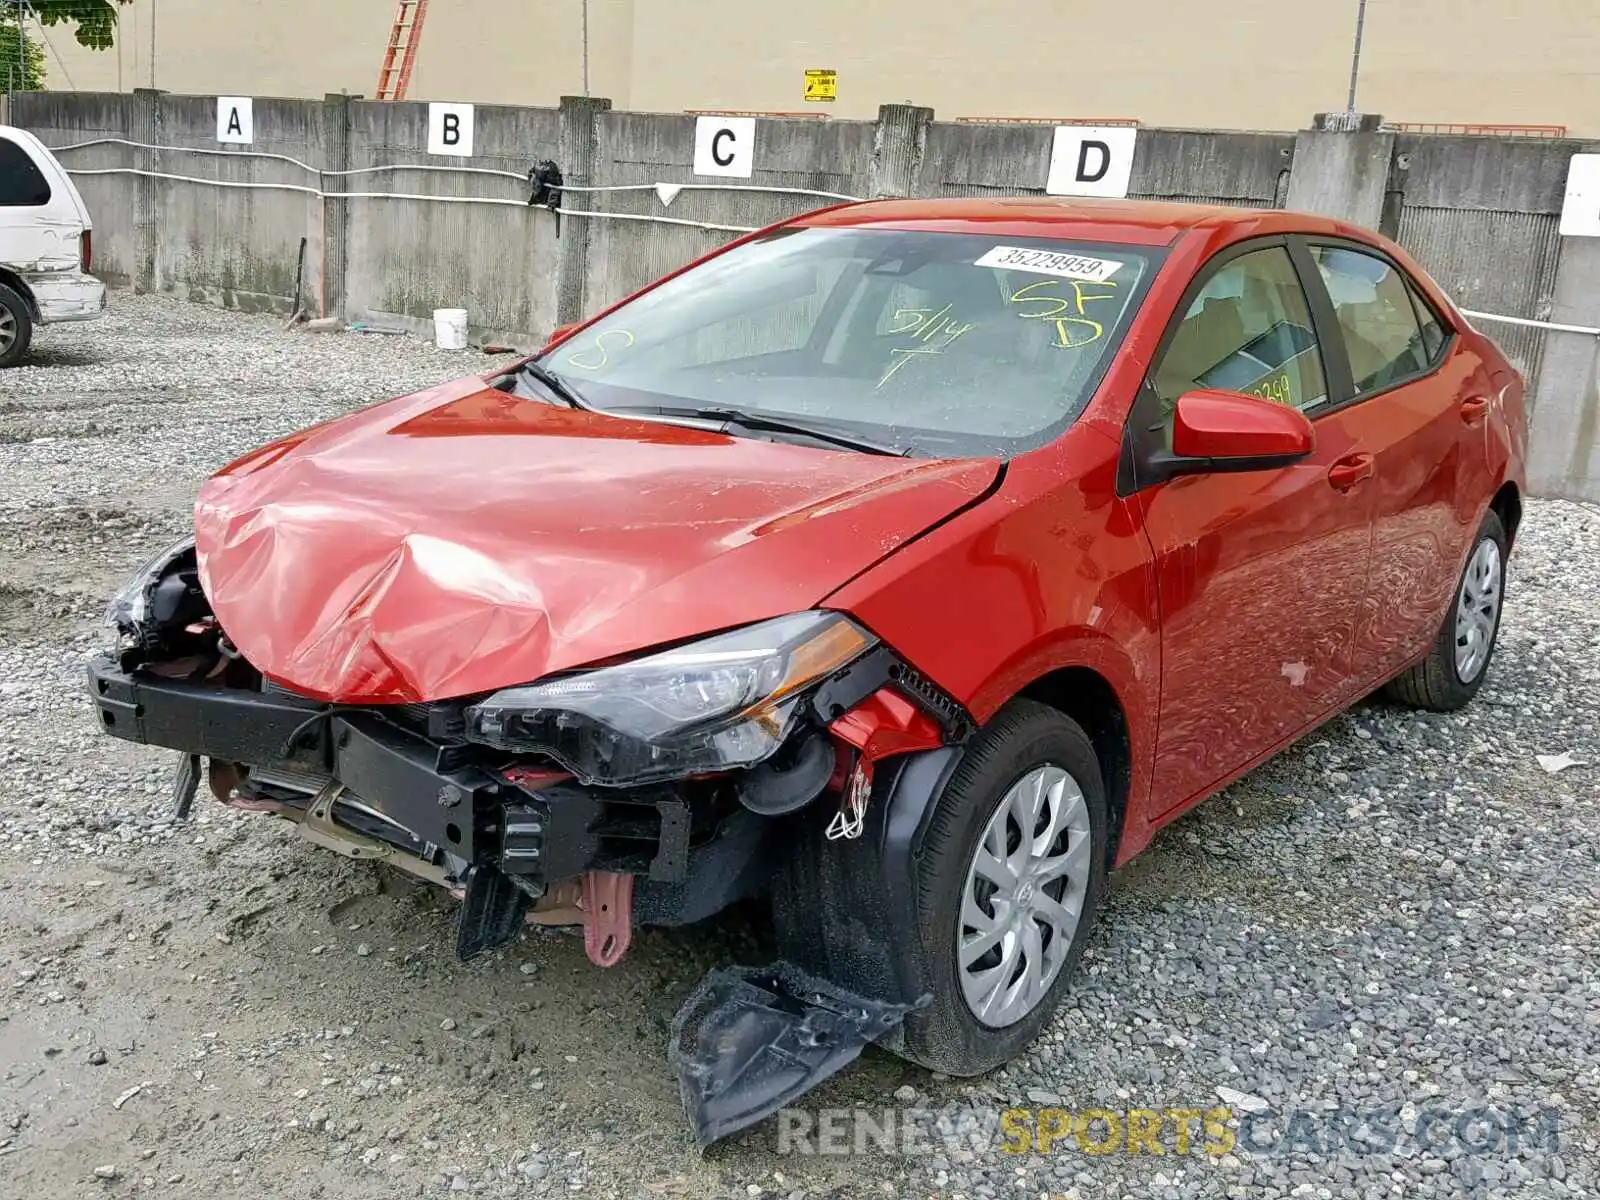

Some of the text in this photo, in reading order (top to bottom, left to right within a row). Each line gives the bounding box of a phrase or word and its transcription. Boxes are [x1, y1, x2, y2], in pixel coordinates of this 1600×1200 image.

[227, 107, 241, 135] A
[443, 114, 460, 146] B
[711, 128, 736, 167] C
[1075, 140, 1111, 183] D
